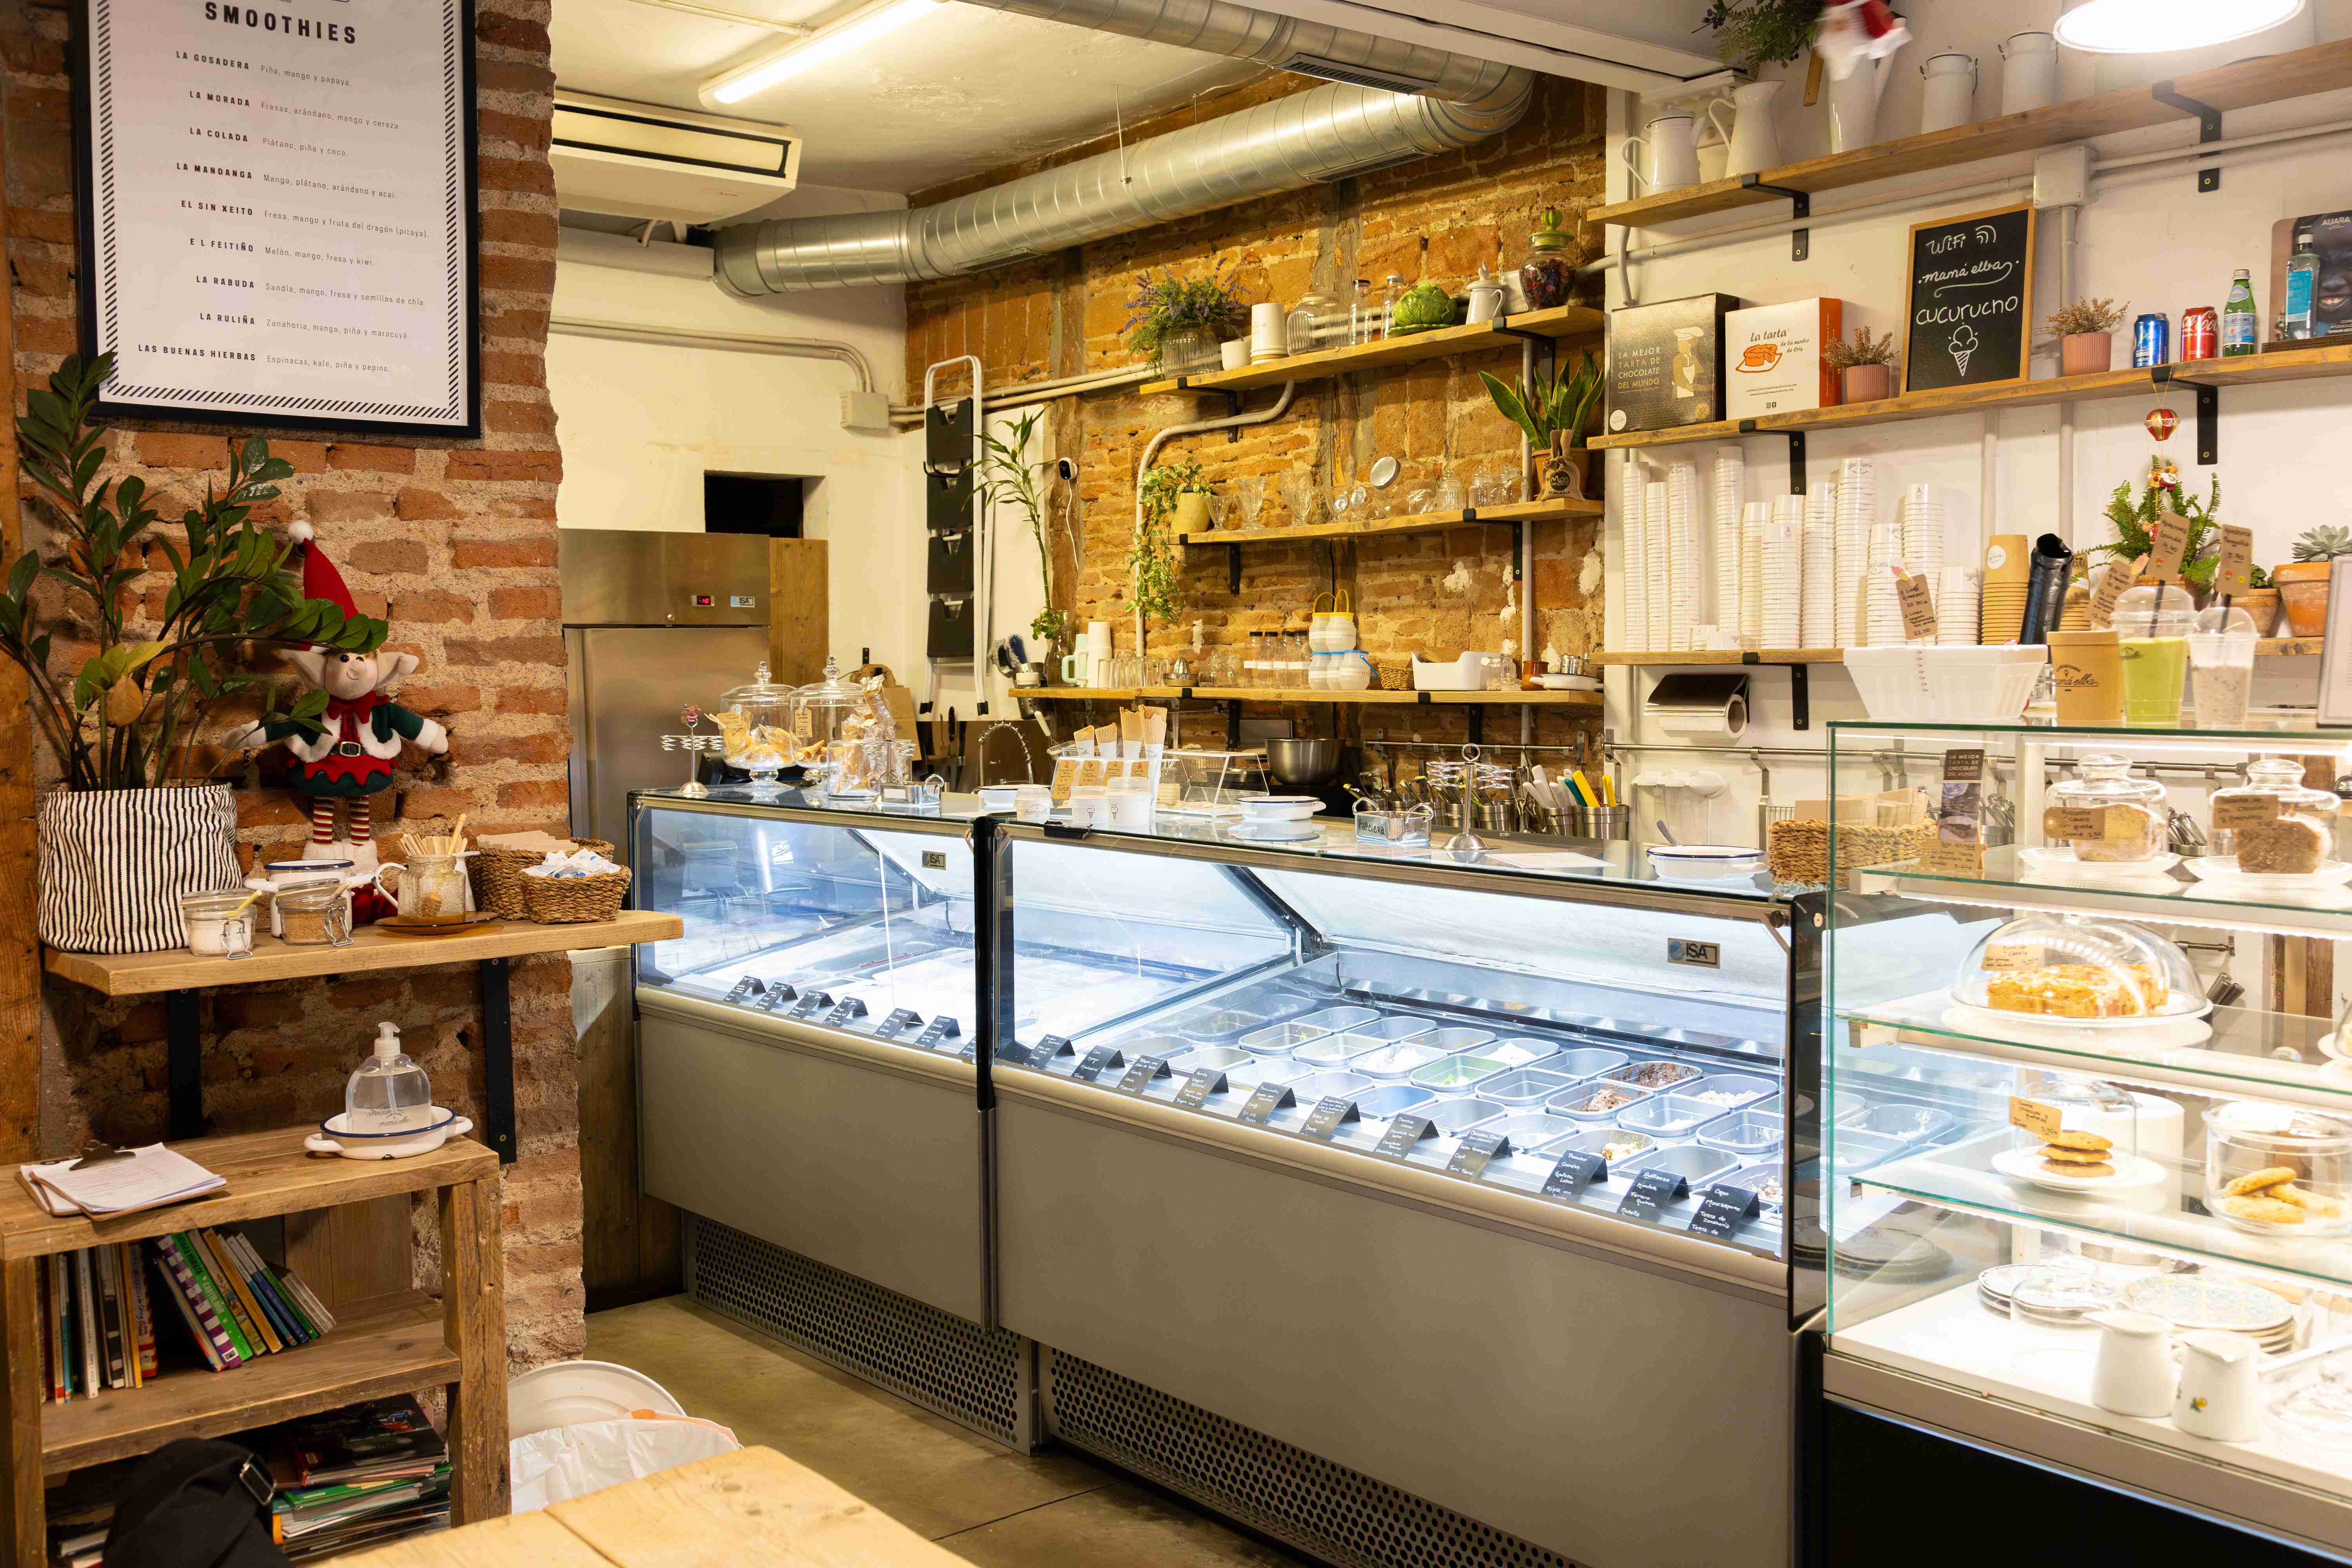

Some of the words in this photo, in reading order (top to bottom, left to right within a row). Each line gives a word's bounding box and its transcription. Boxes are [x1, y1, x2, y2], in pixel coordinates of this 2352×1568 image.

[205, 1, 356, 44] SMOOTHIES
[176, 51, 188, 60] LA
[193, 54, 249, 70] GOSADERA
[261, 65, 280, 76] Piña,
[284, 71, 310, 80] mango
[321, 76, 351, 86] papaya.
[189, 90, 201, 99] LA
[207, 93, 250, 107] MORADA
[261, 102, 290, 114] Fresas,
[294, 108, 334, 120] arándano,
[337, 115, 363, 125] mango
[190, 127, 201, 136] LA
[207, 130, 248, 142] COLADA
[263, 138, 296, 150] Plátano,
[299, 144, 317, 152] piña
[176, 162, 188, 171] LA
[194, 164, 252, 179] MANDANGA
[264, 174, 292, 185] Mango,
[296, 178, 328, 190] plátano,
[332, 184, 368, 195] arándano
[181, 200, 192, 209] EL
[198, 202, 216, 211] SIN
[222, 205, 253, 216] XEITO
[265, 210, 289, 221] Fresa,
[293, 216, 319, 225] mango
[329, 218, 349, 227] fruta
[367, 223, 393, 234] dragón
[396, 227, 429, 238] (pitaya).
[2322, 216, 2350, 226] AUARA
[211, 240, 253, 252] FEITIÑO
[265, 247, 291, 257] Melón,
[295, 252, 323, 261] mango,
[327, 253, 347, 263] fresa
[357, 257, 374, 266] kiwi.
[196, 276, 207, 284] LA
[213, 277, 254, 289] RABUDA
[266, 283, 296, 294] Sandía,
[299, 288, 327, 297] mango,
[330, 289, 350, 298] fresa
[361, 294, 393, 303] semillas
[408, 298, 425, 306] chía.
[200, 312, 212, 321] LA
[217, 314, 254, 325] RULIÑA
[267, 319, 309, 331] Zanahoria,
[313, 325, 340, 334] mango,
[371, 330, 408, 340] maracuyá.
[1750, 332, 1760, 342] La
[1764, 329, 1786, 339] tarta
[138, 344, 157, 353] LAS
[163, 346, 205, 357] BUENAS
[210, 350, 255, 361] HIERBAS
[1632, 347, 1660, 357] MEJOR
[267, 355, 310, 366] Espinacas,
[313, 359, 332, 368] kale,
[1618, 359, 1646, 368] TARTA
[1618, 367, 1659, 379] CHOCOLATE
[1632, 377, 1659, 388] MUNDO
